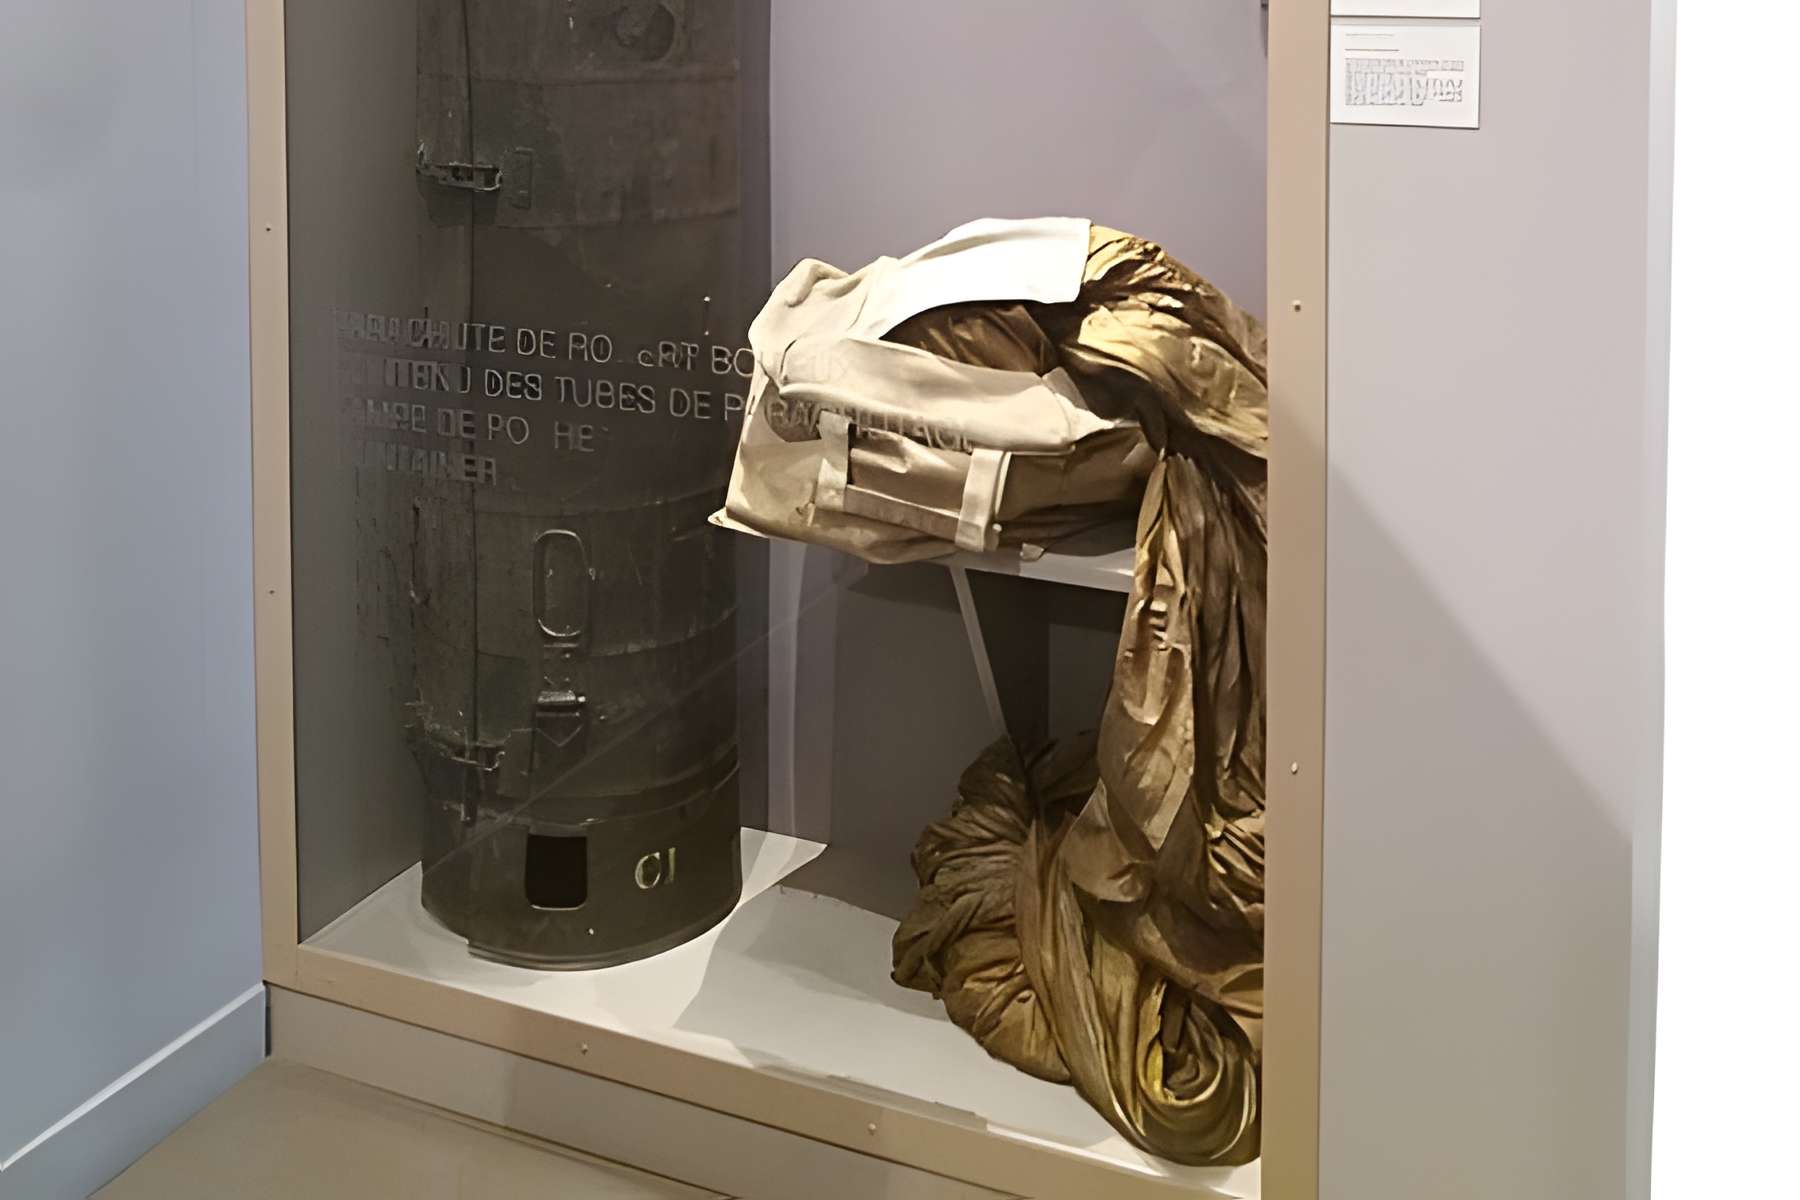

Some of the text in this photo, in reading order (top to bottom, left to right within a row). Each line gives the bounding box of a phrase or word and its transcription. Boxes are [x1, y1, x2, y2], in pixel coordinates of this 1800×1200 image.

[516, 326, 557, 359] DE
[484, 368, 543, 401] DES
[554, 376, 656, 414] TUBES
[669, 387, 713, 420] DE
[437, 407, 477, 440] DE
